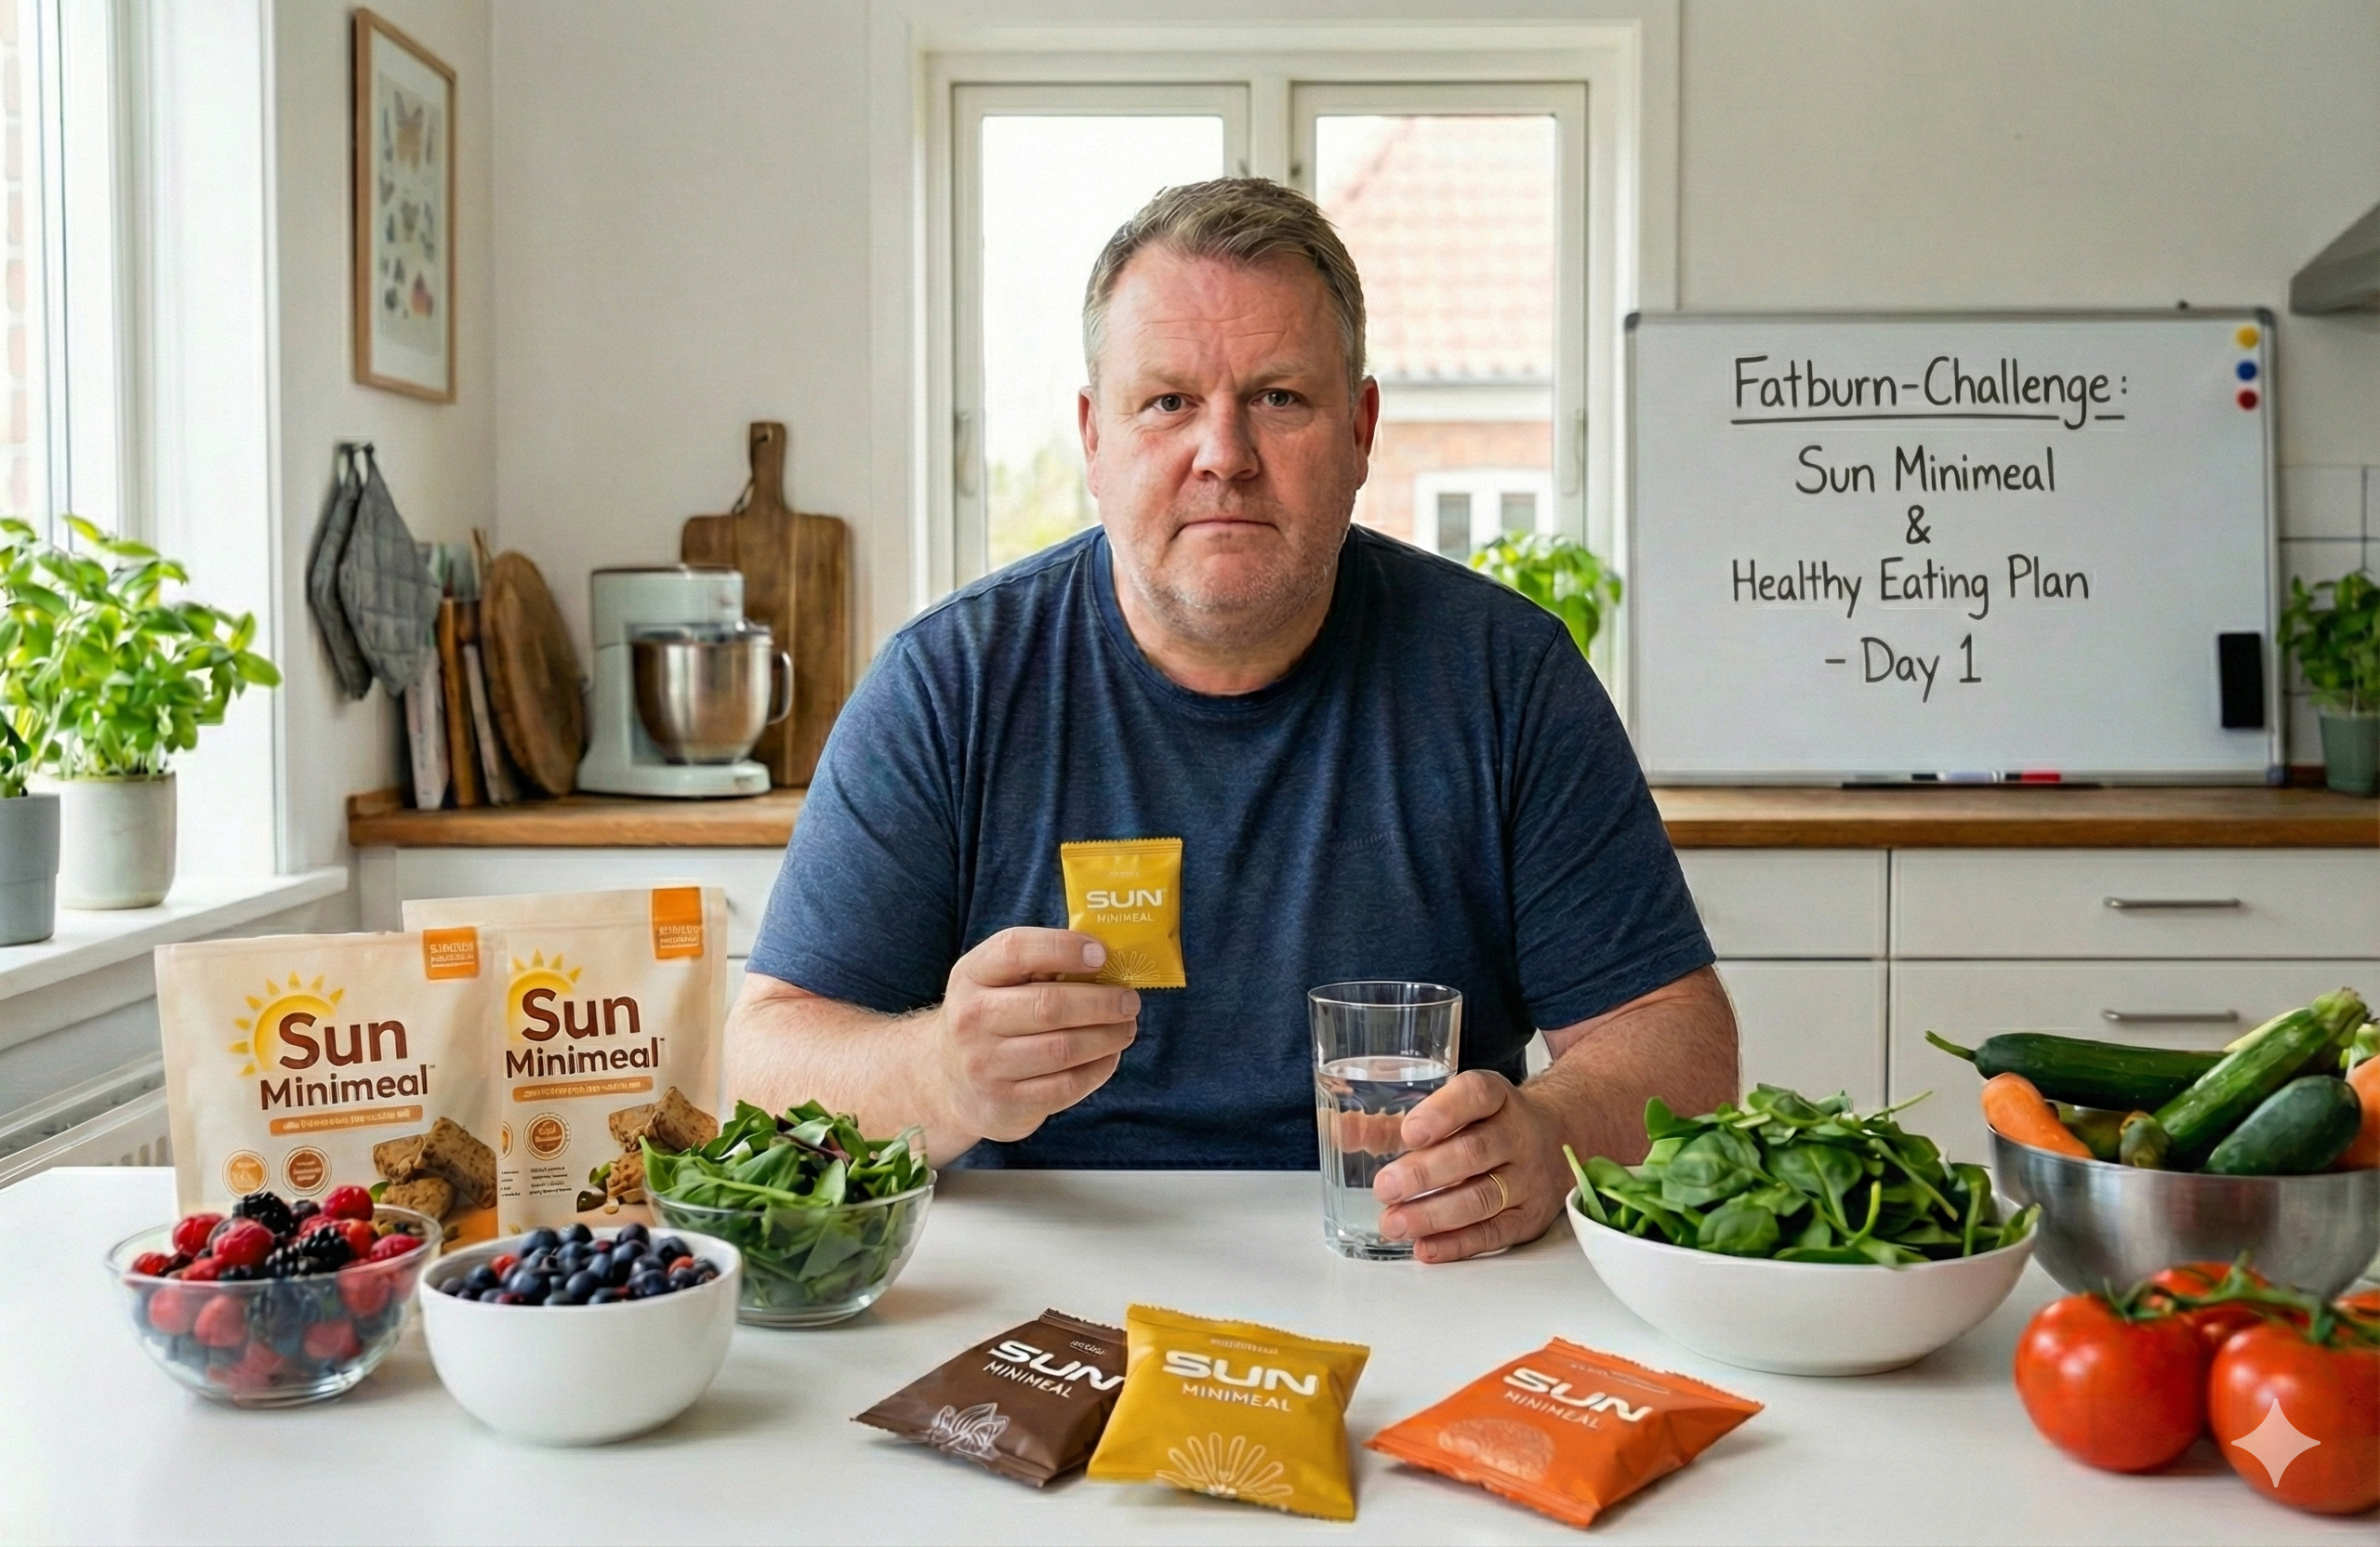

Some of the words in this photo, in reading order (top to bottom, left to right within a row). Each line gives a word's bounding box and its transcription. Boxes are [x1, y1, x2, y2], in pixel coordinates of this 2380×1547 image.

[1734, 355, 2127, 430] Fatburn-Challenge:
[1795, 444, 1876, 495] Sun
[1895, 444, 2055, 492] Minimeal
[1906, 505, 1931, 545] &
[1732, 559, 1862, 618] Healthy
[1880, 556, 1990, 620] Eating
[2007, 553, 2090, 600] Plan
[1861, 636, 1940, 703] Day
[1959, 633, 1981, 683] 1
[1086, 889, 1163, 909] SUN
[521, 987, 641, 1042] Sun
[278, 1012, 408, 1070] Sun
[506, 1037, 659, 1079] Minimeal
[259, 1064, 428, 1111] Minimeal
[982, 1360, 1073, 1399] MINIMEAL
[986, 1340, 1125, 1392] SUN
[1162, 1349, 1318, 1396] SUN
[1181, 1382, 1292, 1412] MINIMEAL
[1502, 1367, 1653, 1422] SUN
